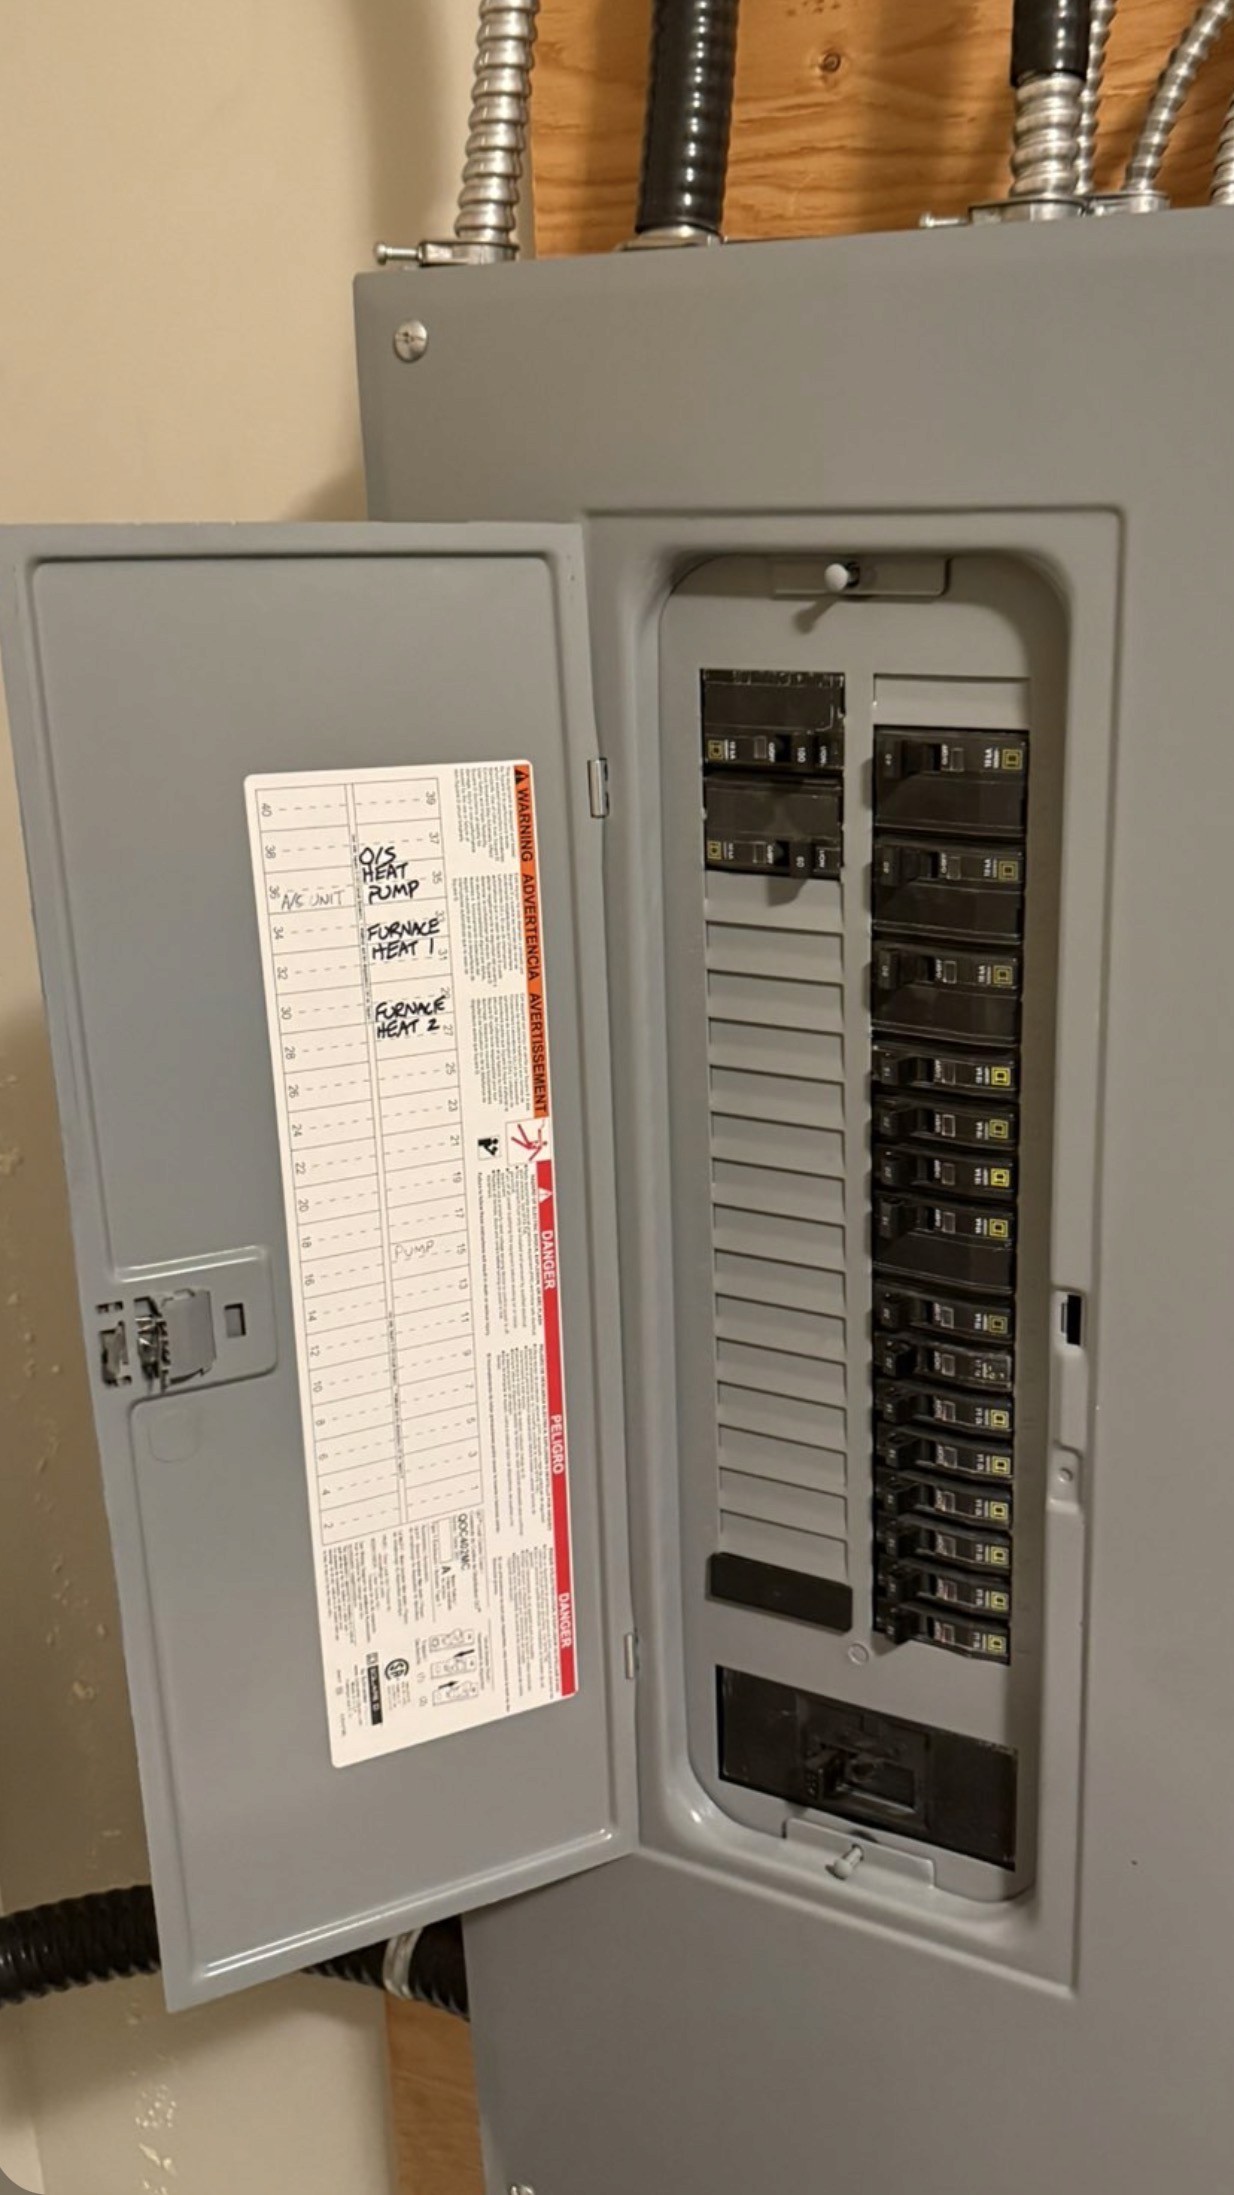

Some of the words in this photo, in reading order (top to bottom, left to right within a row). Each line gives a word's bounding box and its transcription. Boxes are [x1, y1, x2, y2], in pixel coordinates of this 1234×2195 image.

[515, 787, 533, 862] WARNING
[359, 845, 396, 866] O/S
[362, 862, 409, 883] HEAT
[311, 889, 345, 907] UNIT
[368, 879, 420, 905] PUMP
[367, 917, 441, 941] FURNACE
[522, 873, 541, 982] ADVERTENCIA
[372, 940, 418, 960] HEAT
[429, 937, 434, 955] 1
[375, 995, 447, 1022] FURNACE
[376, 1019, 420, 1038] HEAT
[427, 1018, 440, 1032] 2
[529, 993, 549, 1112] AVERTISSEMENT
[540, 1229, 556, 1290] DANGER
[550, 1414, 565, 1475] PELIGRO
[557, 1592, 572, 1648] DANGER
